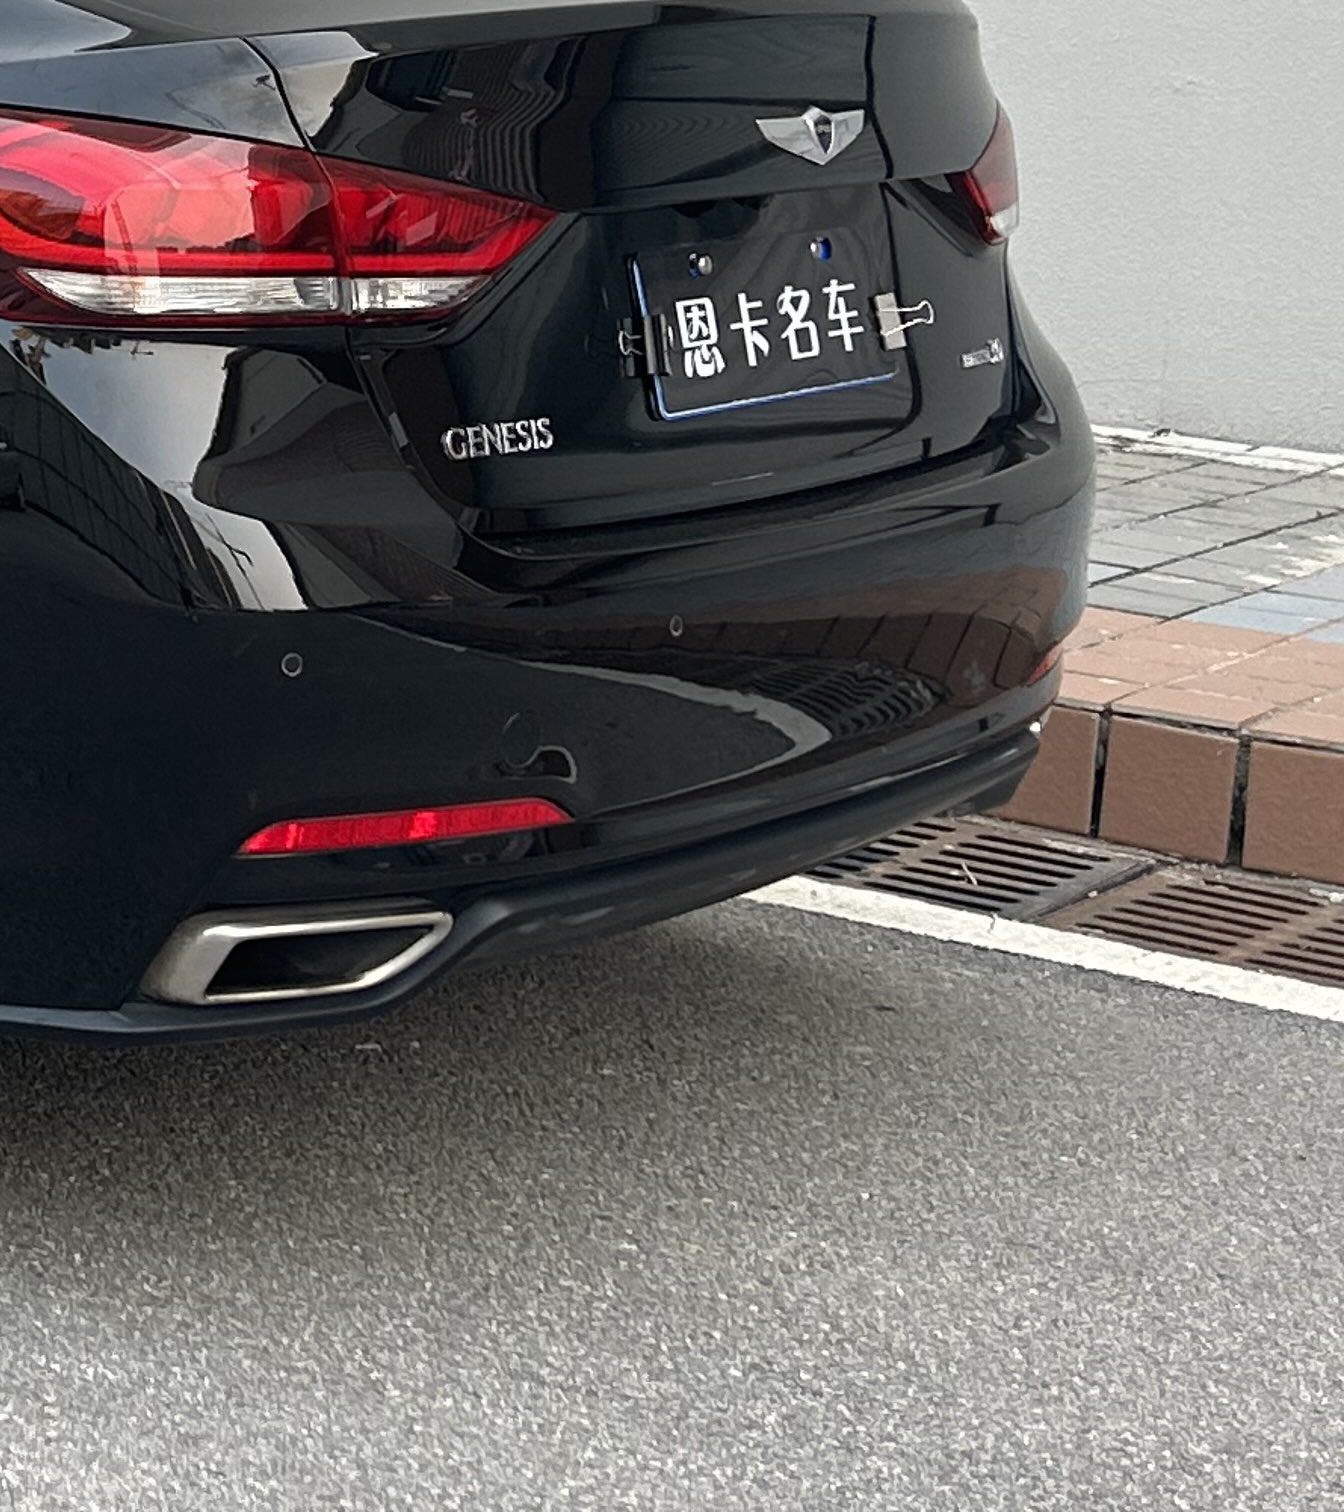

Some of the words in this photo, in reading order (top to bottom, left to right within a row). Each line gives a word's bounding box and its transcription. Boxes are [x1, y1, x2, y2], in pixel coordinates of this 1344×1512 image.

[675, 278, 864, 378] 恩卡名车
[440, 417, 554, 460] GENESIS
